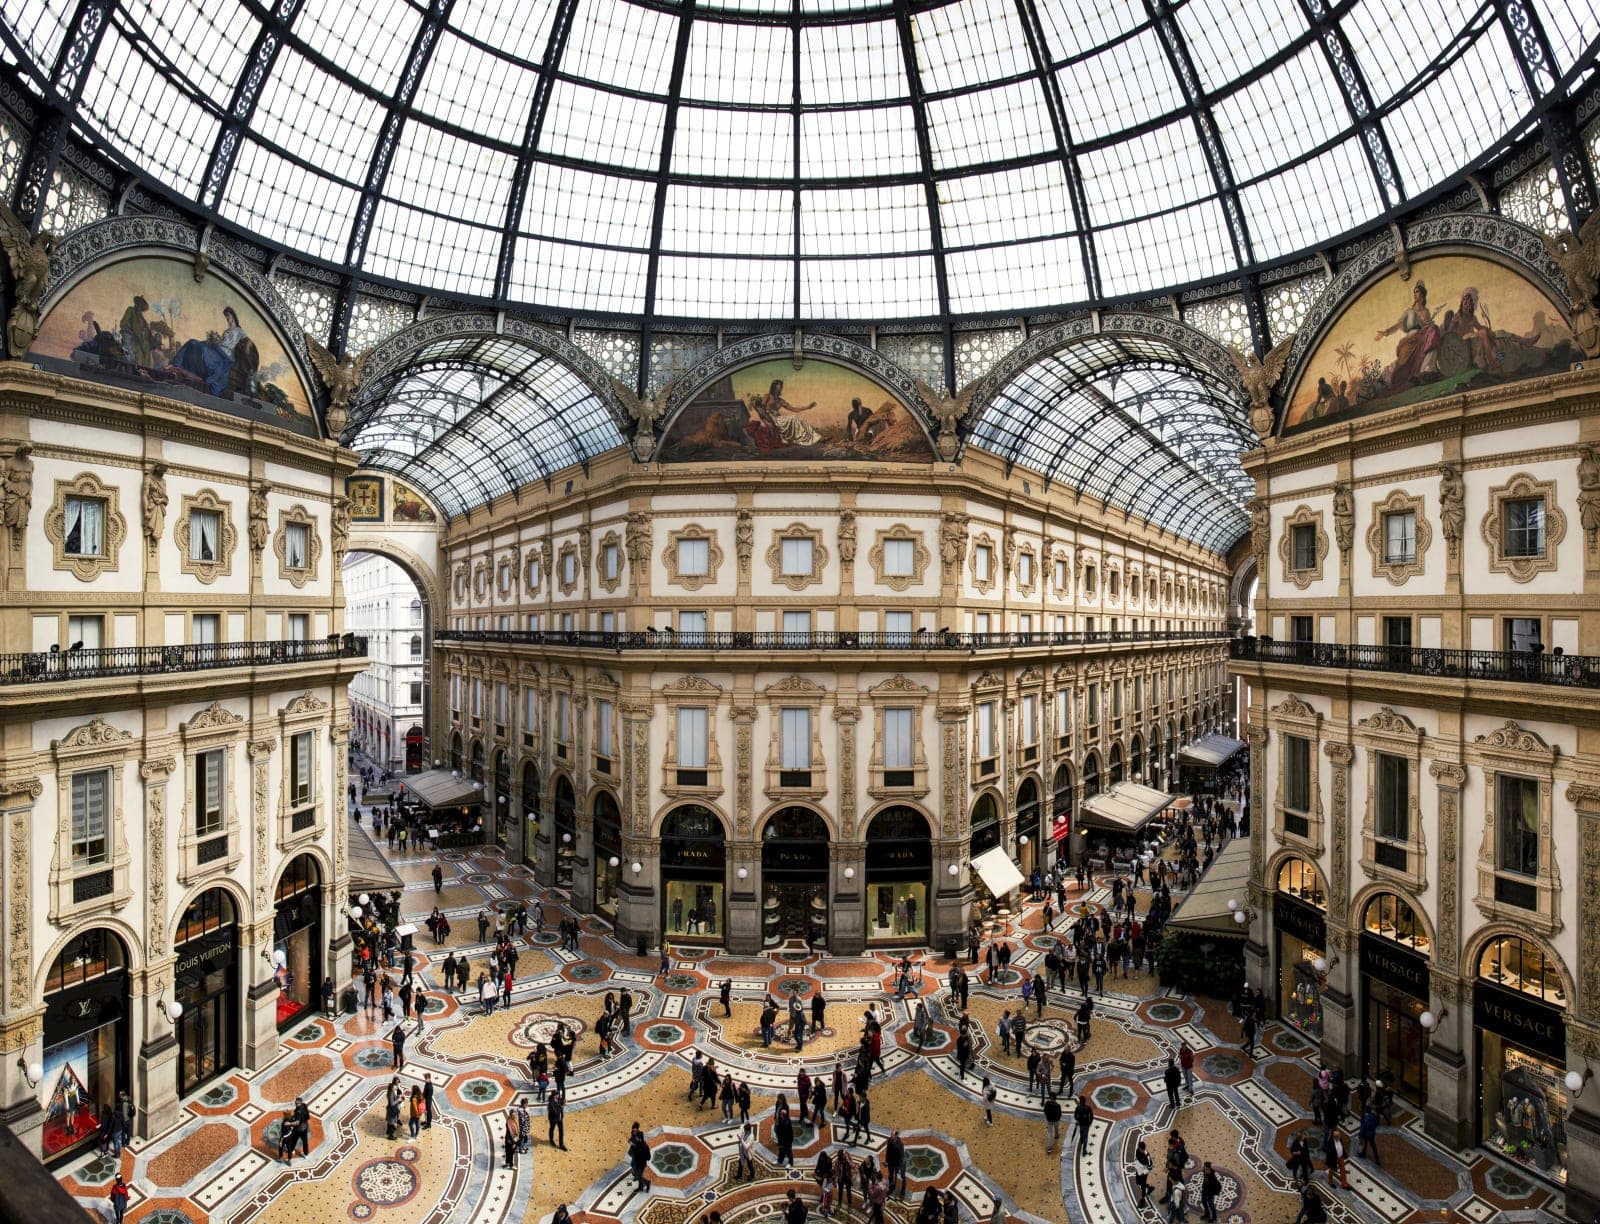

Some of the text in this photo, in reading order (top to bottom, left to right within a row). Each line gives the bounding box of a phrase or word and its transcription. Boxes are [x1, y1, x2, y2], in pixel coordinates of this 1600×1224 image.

[175, 941, 232, 973] LOUIS VUITTON
[1368, 949, 1422, 984] VERSACE
[1484, 1000, 1555, 1038] VERSACE
